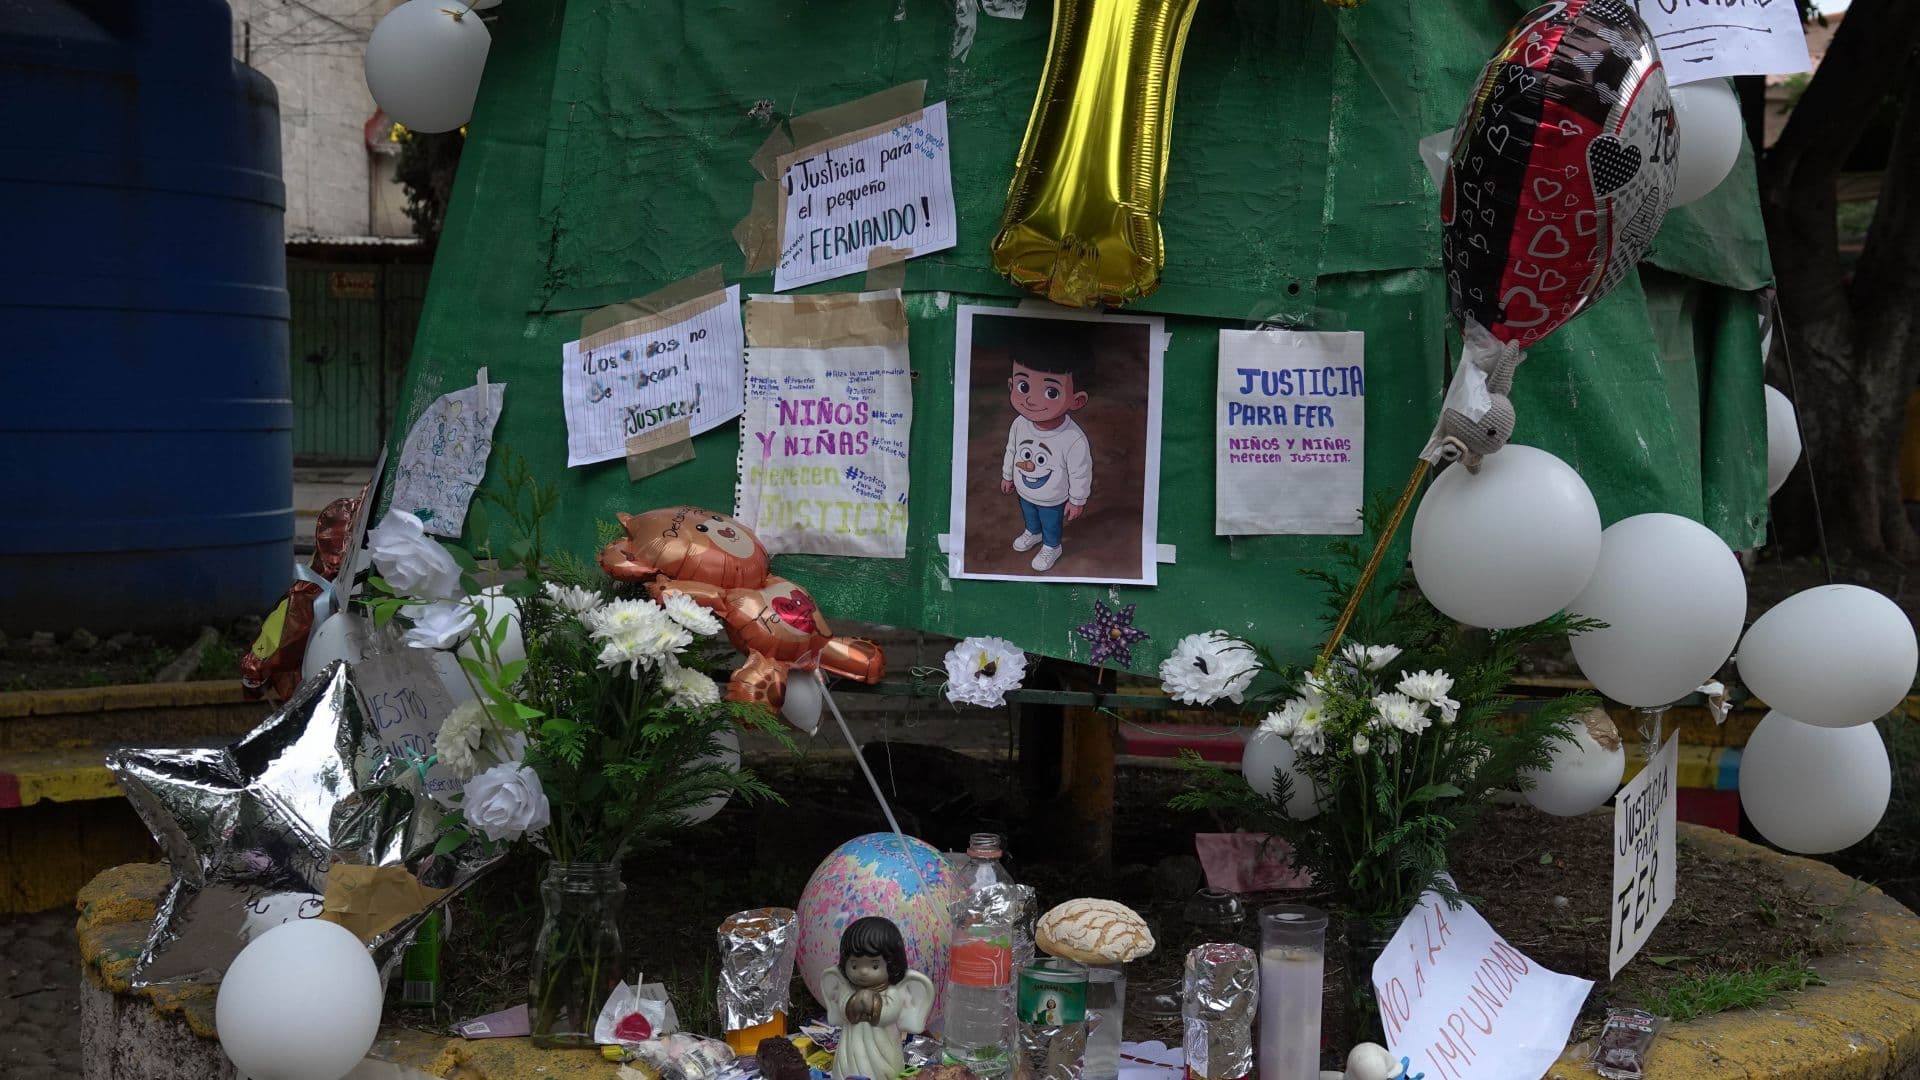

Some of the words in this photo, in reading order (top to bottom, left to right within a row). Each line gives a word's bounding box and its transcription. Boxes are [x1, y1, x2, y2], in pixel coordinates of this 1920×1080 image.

[881, 142, 912, 172] para
[798, 194, 812, 220] el
[827, 179, 886, 217] pequeño
[689, 328, 707, 344] no
[1236, 365, 1365, 397] JUSTICIA
[779, 396, 870, 426] NIÑOS
[1228, 401, 1288, 426] PARA
[1293, 403, 1335, 429] FER
[754, 430, 777, 460] Y
[784, 429, 870, 457] NIÑAS
[1229, 435, 1280, 451] NIÑOS
[1286, 438, 1296, 450] Y
[1302, 437, 1352, 451] NIÑAS
[758, 493, 907, 536] JUSTICIA
[1619, 764, 1668, 857] JUSTICIA
[1634, 823, 1660, 874] PARA
[1616, 850, 1659, 955] FER
[1379, 976, 1411, 1048] NO
[1423, 902, 1453, 966] LA
[1424, 940, 1530, 1080] IMPUNIDAD
